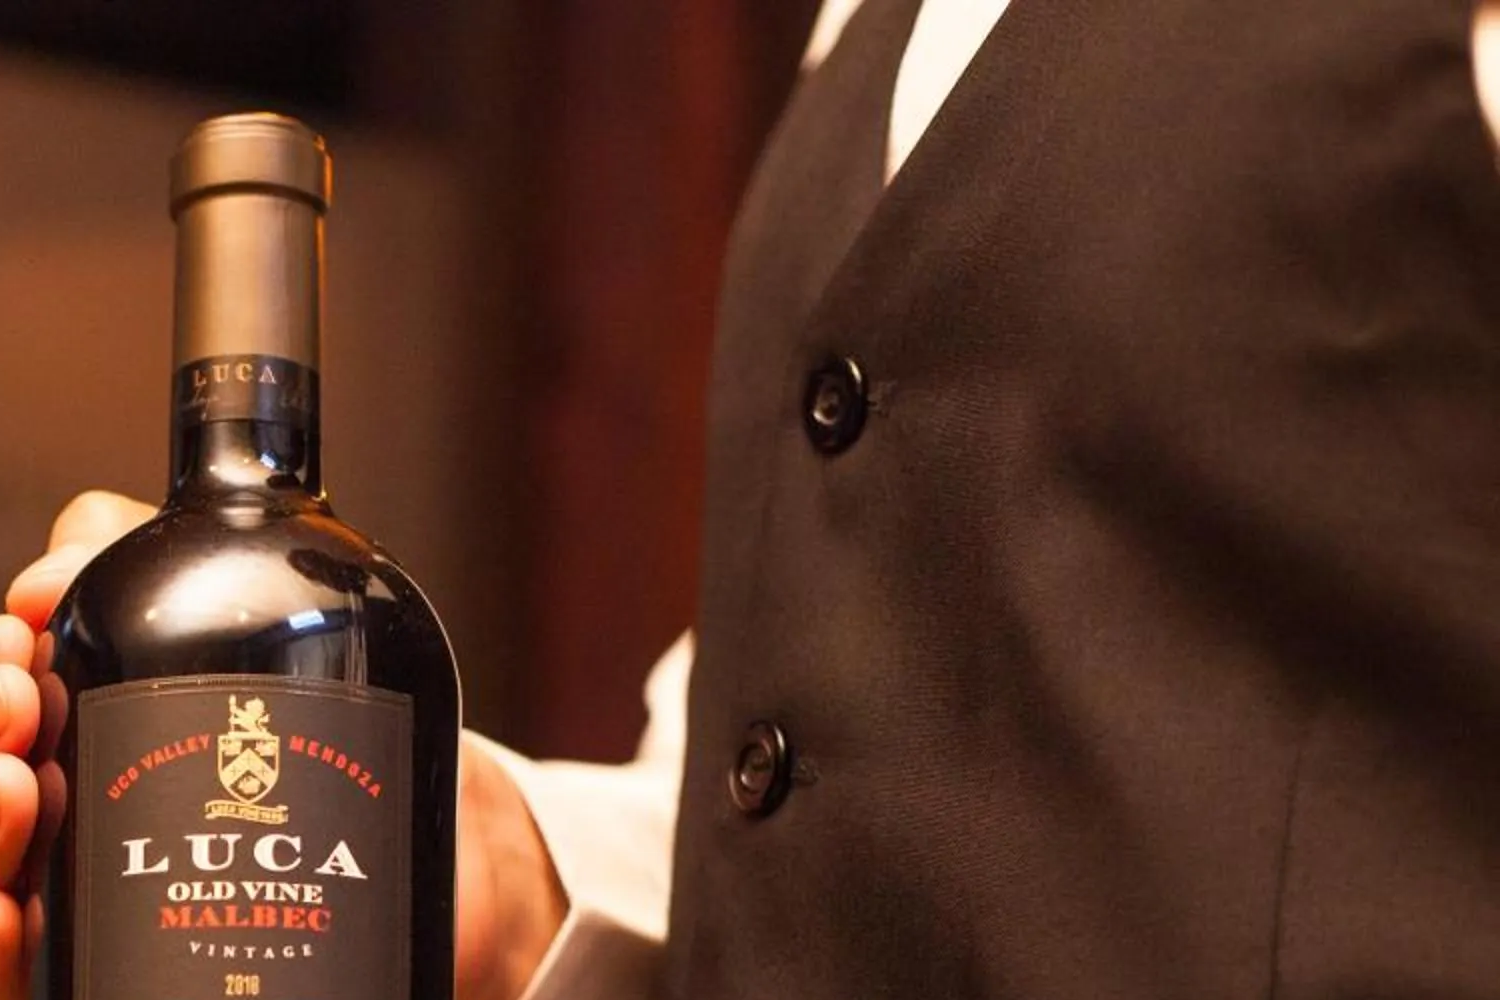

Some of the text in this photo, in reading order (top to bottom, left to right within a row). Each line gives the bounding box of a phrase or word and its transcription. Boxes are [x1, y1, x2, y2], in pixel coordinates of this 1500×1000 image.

[193, 362, 277, 388] LUCA
[107, 733, 381, 800] UCO VALLEY MENDOZA
[121, 833, 368, 880] LUCA
[167, 881, 324, 905] OLD VINE
[159, 904, 333, 934] MALBEC
[189, 941, 314, 959] VINTAGE
